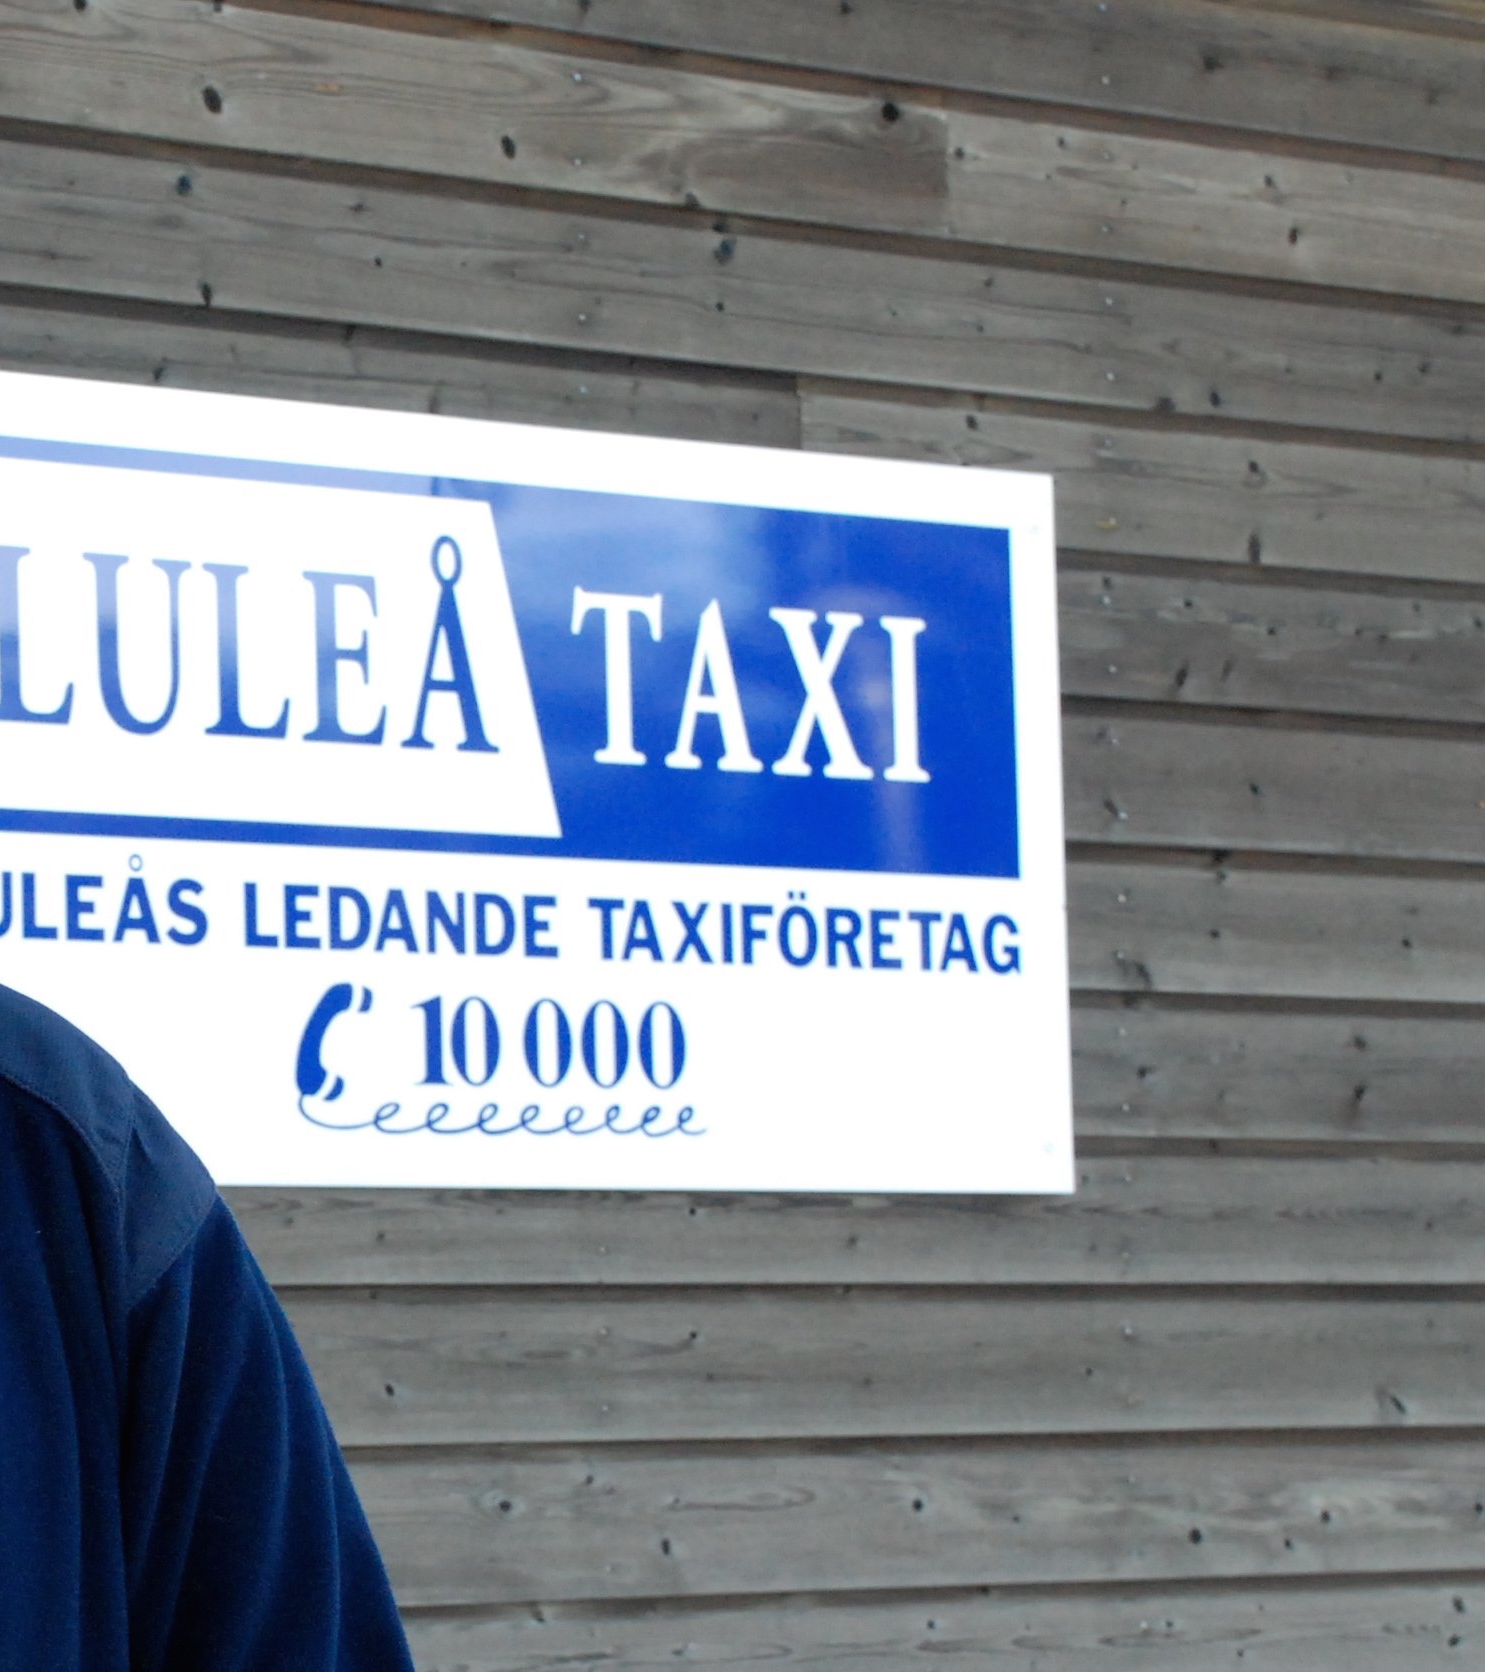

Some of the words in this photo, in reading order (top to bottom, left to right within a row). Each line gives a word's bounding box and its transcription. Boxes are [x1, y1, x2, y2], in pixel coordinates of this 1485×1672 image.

[571, 585, 931, 783] TAXI
[242, 880, 561, 960] LEDANDE
[587, 890, 1023, 977] TAXIFÖRETAG
[410, 994, 502, 1088] 10
[522, 997, 688, 1091] 000
